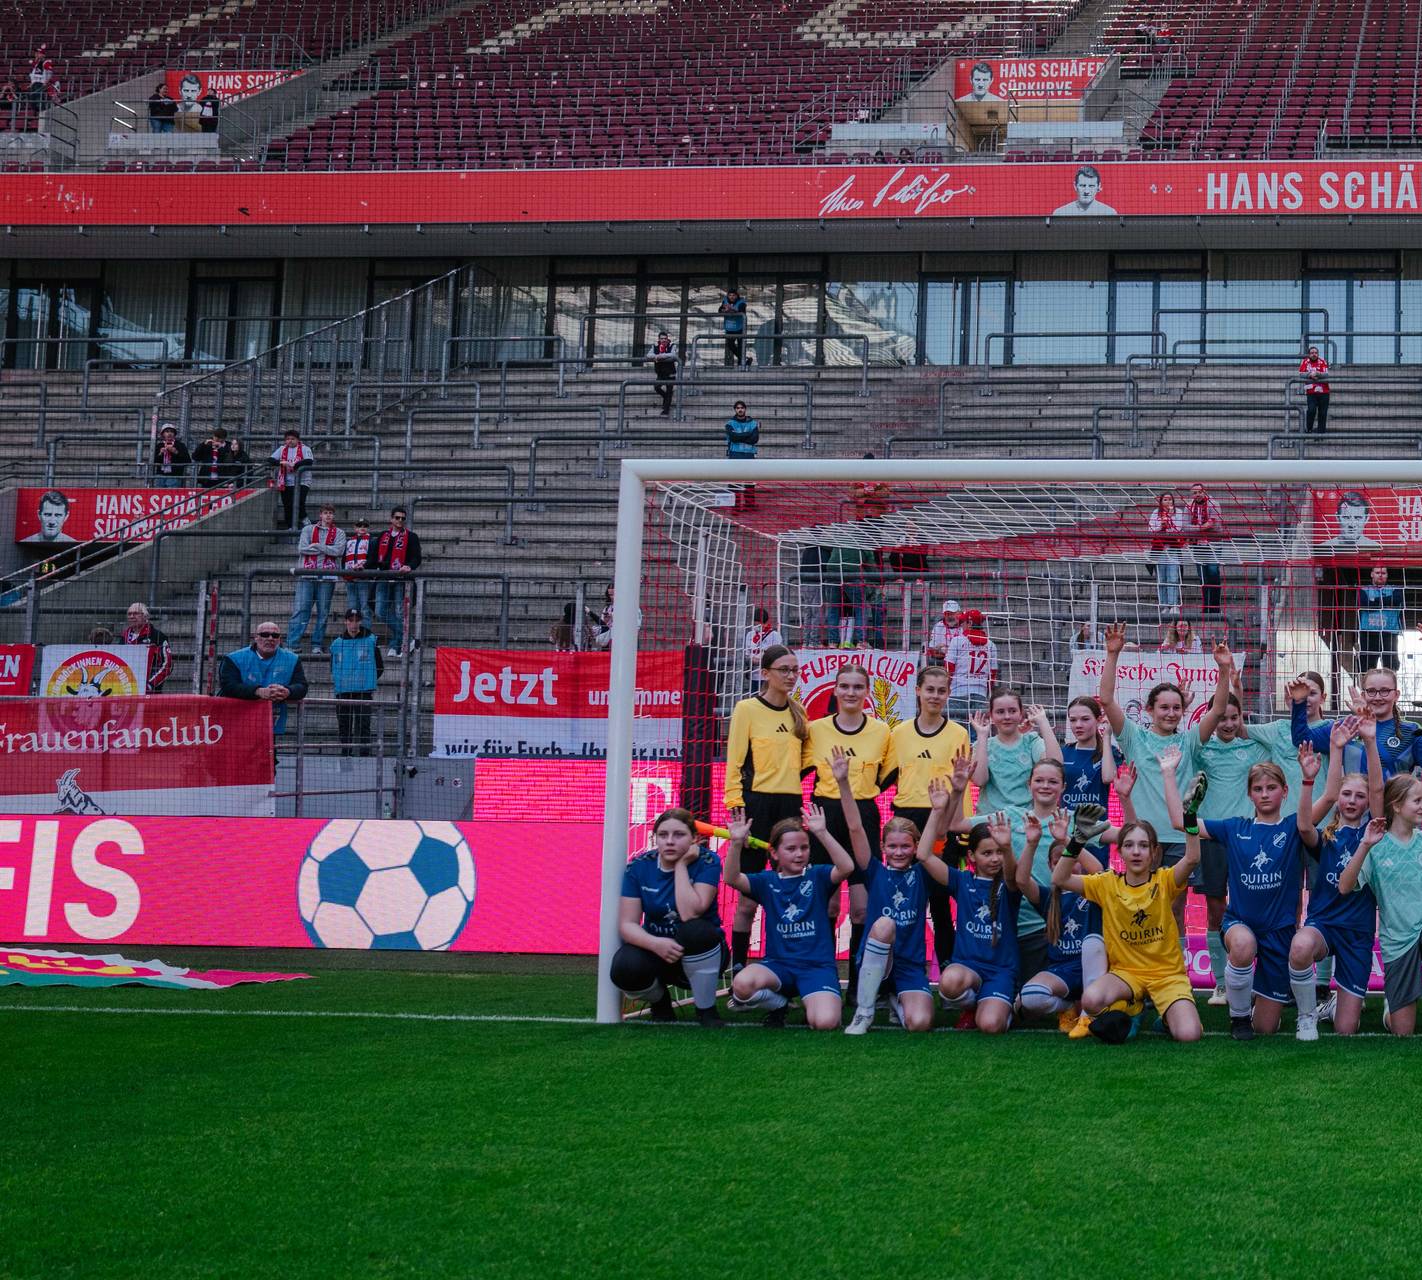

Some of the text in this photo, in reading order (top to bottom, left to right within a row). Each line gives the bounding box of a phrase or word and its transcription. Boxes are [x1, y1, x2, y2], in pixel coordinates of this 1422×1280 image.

[1000, 63, 1036, 78] HANS
[207, 75, 242, 89] HANS
[999, 79, 1073, 97] SÜDKURVE
[1206, 172, 1303, 210] HANS
[95, 494, 143, 515] HANS
[968, 650, 989, 676] 12
[453, 661, 558, 706] Jetzt
[445, 739, 479, 757] wir
[1063, 793, 1100, 804] QUIRIN
[1241, 870, 1282, 885] QUIRIN
[966, 921, 1002, 934] QUIRN
[1119, 925, 1164, 942] QUIRIN
